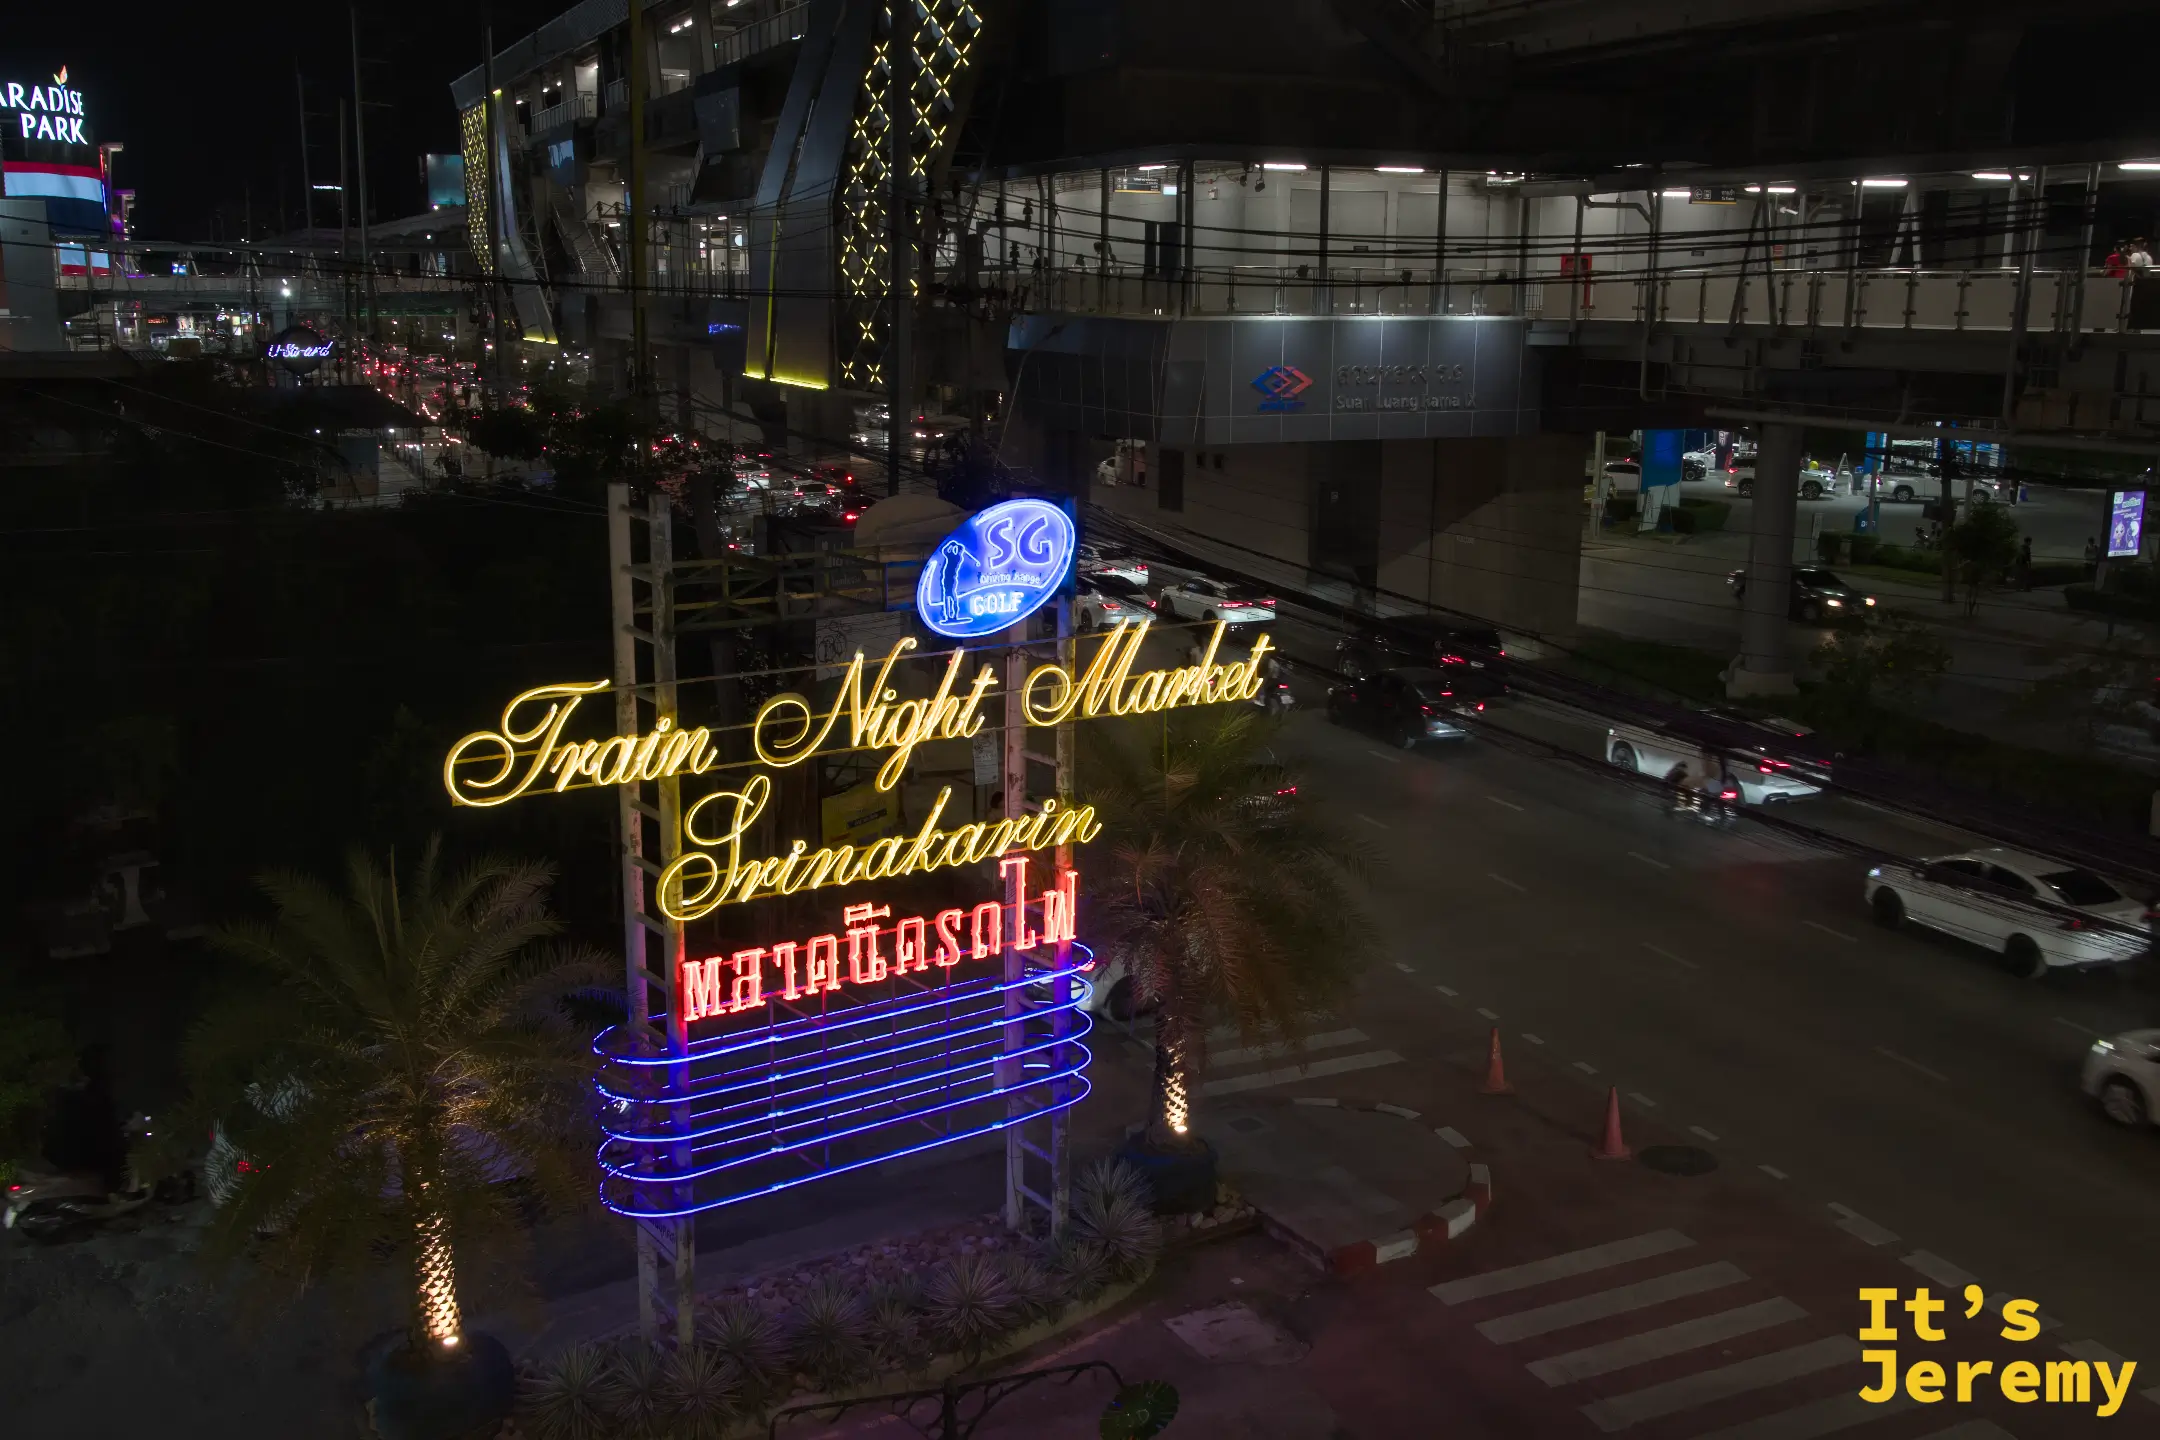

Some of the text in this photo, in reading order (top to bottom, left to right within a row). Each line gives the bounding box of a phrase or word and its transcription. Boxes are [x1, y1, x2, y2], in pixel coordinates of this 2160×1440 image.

[0, 82, 85, 117] RADISE
[20, 112, 89, 145] PARK
[1376, 393, 1418, 411] Luang
[986, 514, 1053, 570] SG
[970, 591, 1025, 617] GOLF
[443, 678, 719, 807] Train
[754, 636, 999, 793] Night
[1021, 615, 1276, 727] Market
[656, 774, 1103, 921] Srinakarin
